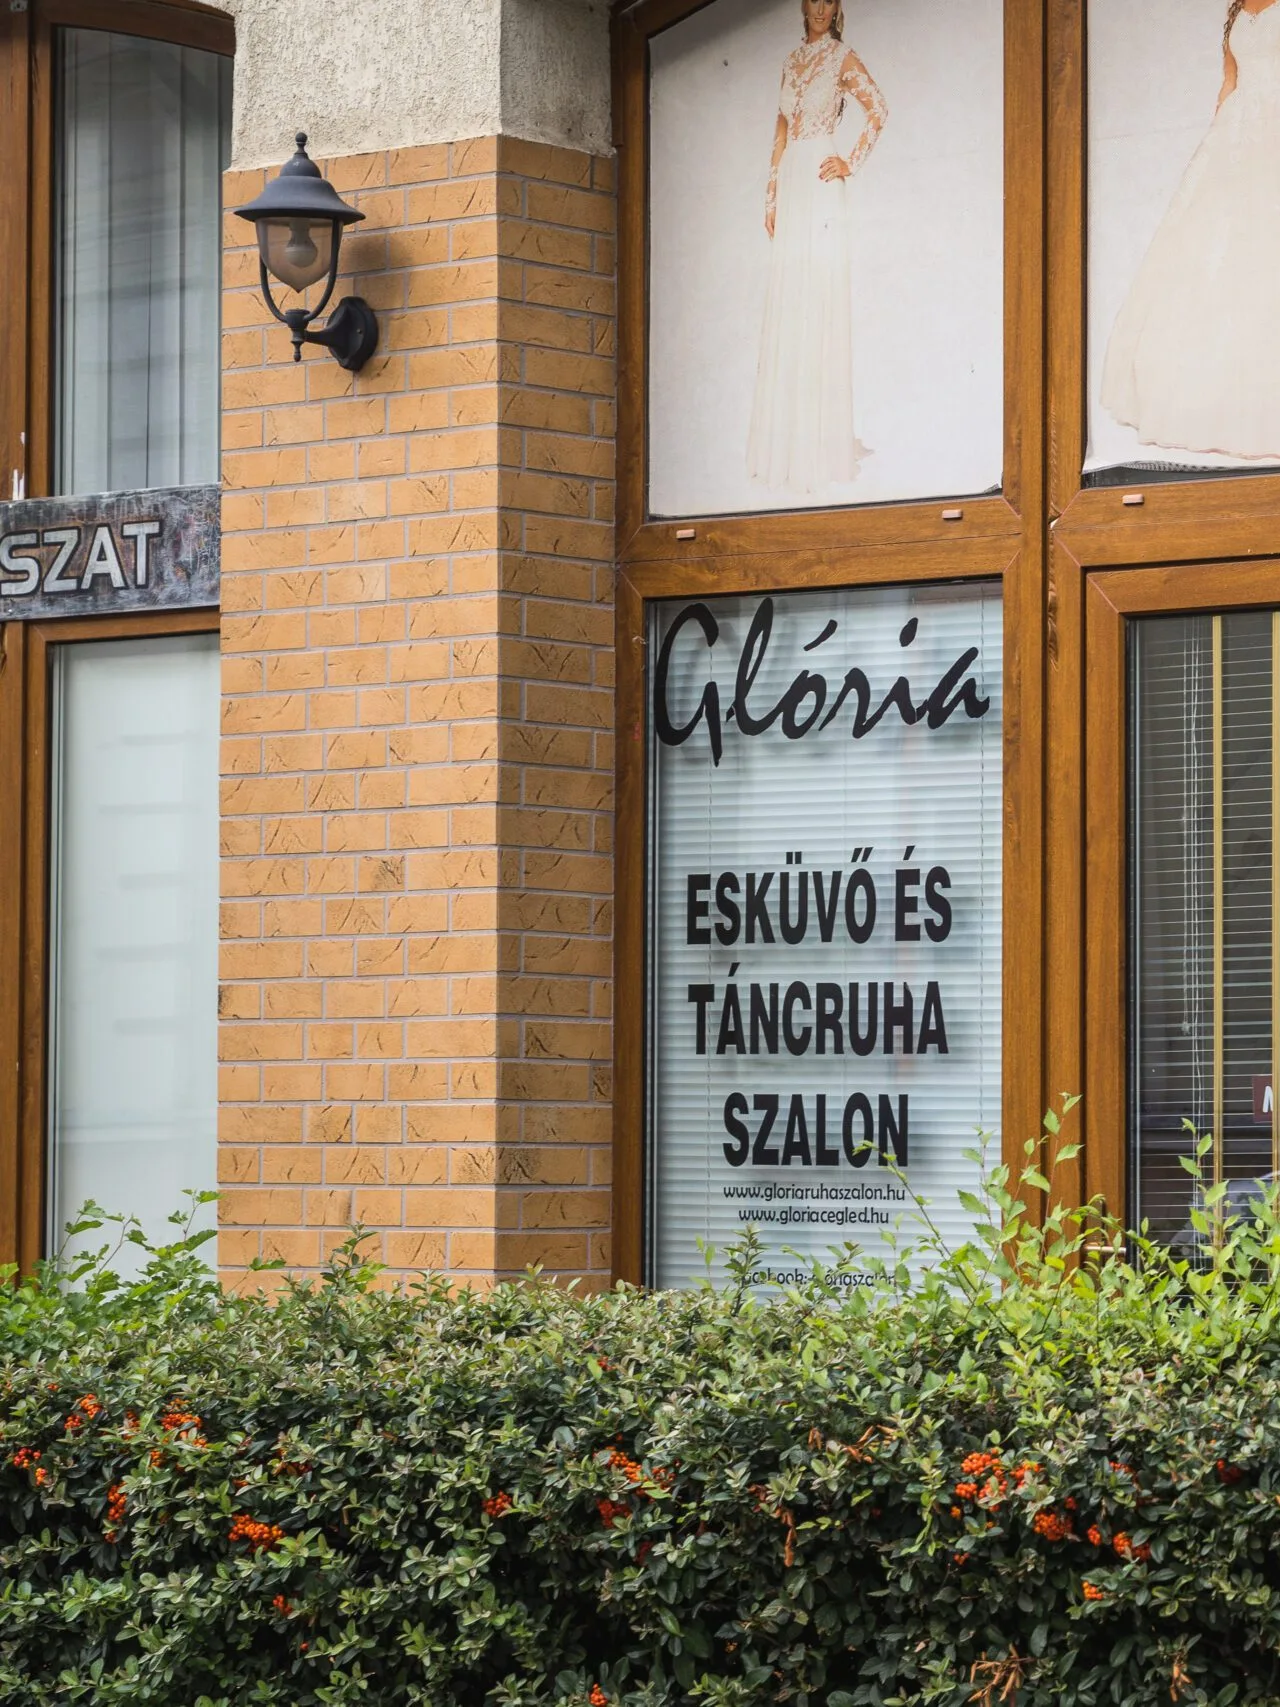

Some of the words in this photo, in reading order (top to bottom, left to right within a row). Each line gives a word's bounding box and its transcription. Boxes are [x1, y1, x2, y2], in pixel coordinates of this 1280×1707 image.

[0, 520, 161, 596] SZAT
[654, 597, 990, 767] Glória
[686, 847, 877, 946] ESKÜVŐ
[894, 845, 953, 944] ÉS
[688, 962, 950, 1056] TÁNCRUHA
[722, 1092, 909, 1168] SZALON
[723, 1183, 906, 1201] www.gloriaruhaszalon.hu
[738, 1206, 889, 1225] www.gloriacegled.hu
